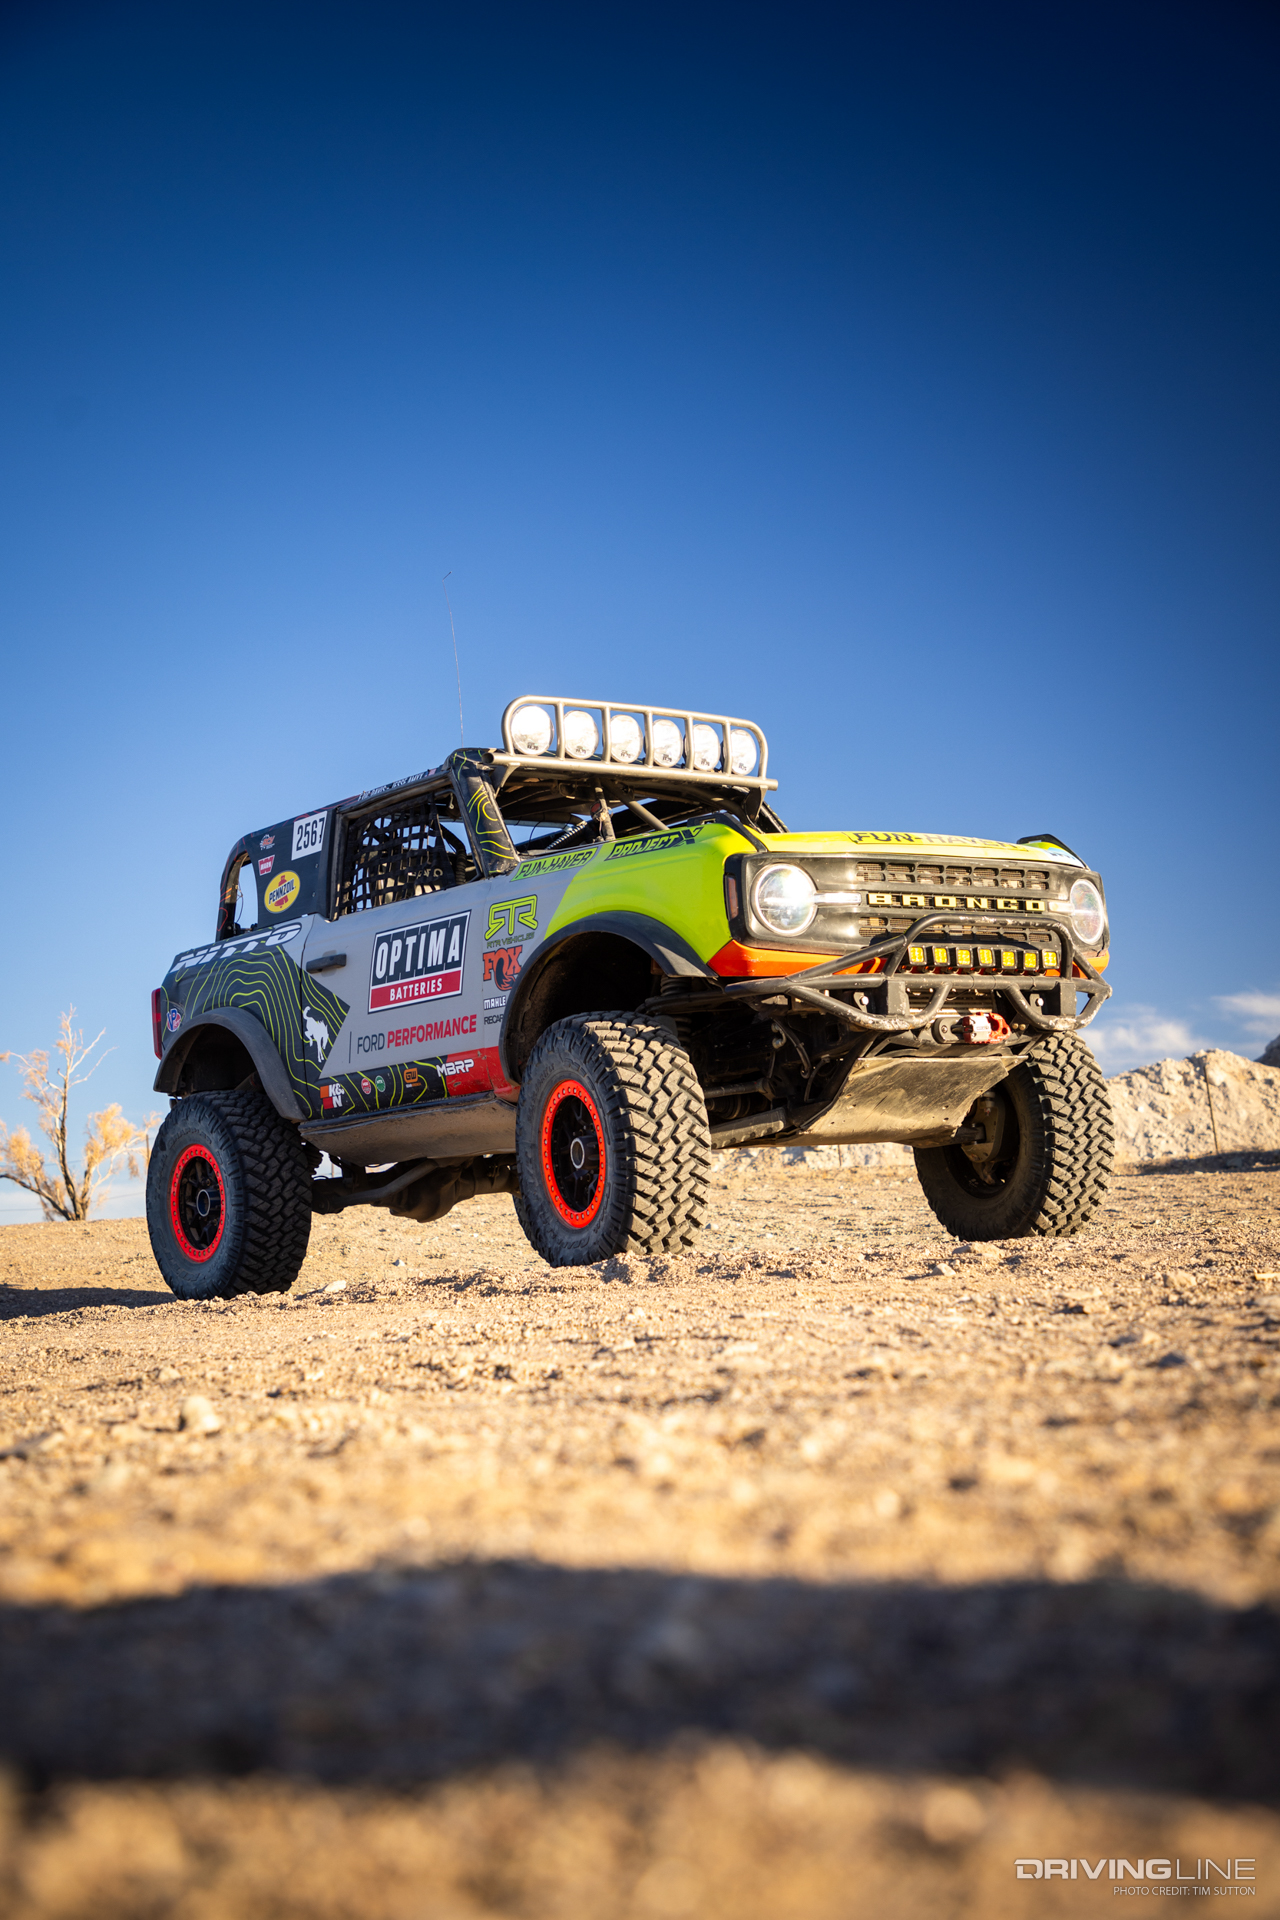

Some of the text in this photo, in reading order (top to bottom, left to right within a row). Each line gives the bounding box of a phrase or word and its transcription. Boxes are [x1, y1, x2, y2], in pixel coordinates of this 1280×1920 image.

[296, 817, 325, 852] 2567
[609, 834, 680, 859] PROJECT
[515, 851, 593, 879] FUN-HAVER
[268, 878, 295, 905] PENNZOIL
[868, 892, 1045, 912] BRONCO
[169, 922, 301, 973] NITTO
[375, 924, 460, 979] OPTIMA
[483, 945, 522, 991] FOX
[389, 978, 442, 1001] BATTERIES
[484, 996, 506, 1010] MAHLE
[484, 1014, 504, 1025] RECAR
[357, 1014, 477, 1054] FORD PERFORMANCE
[436, 1058, 475, 1077] MBRP
